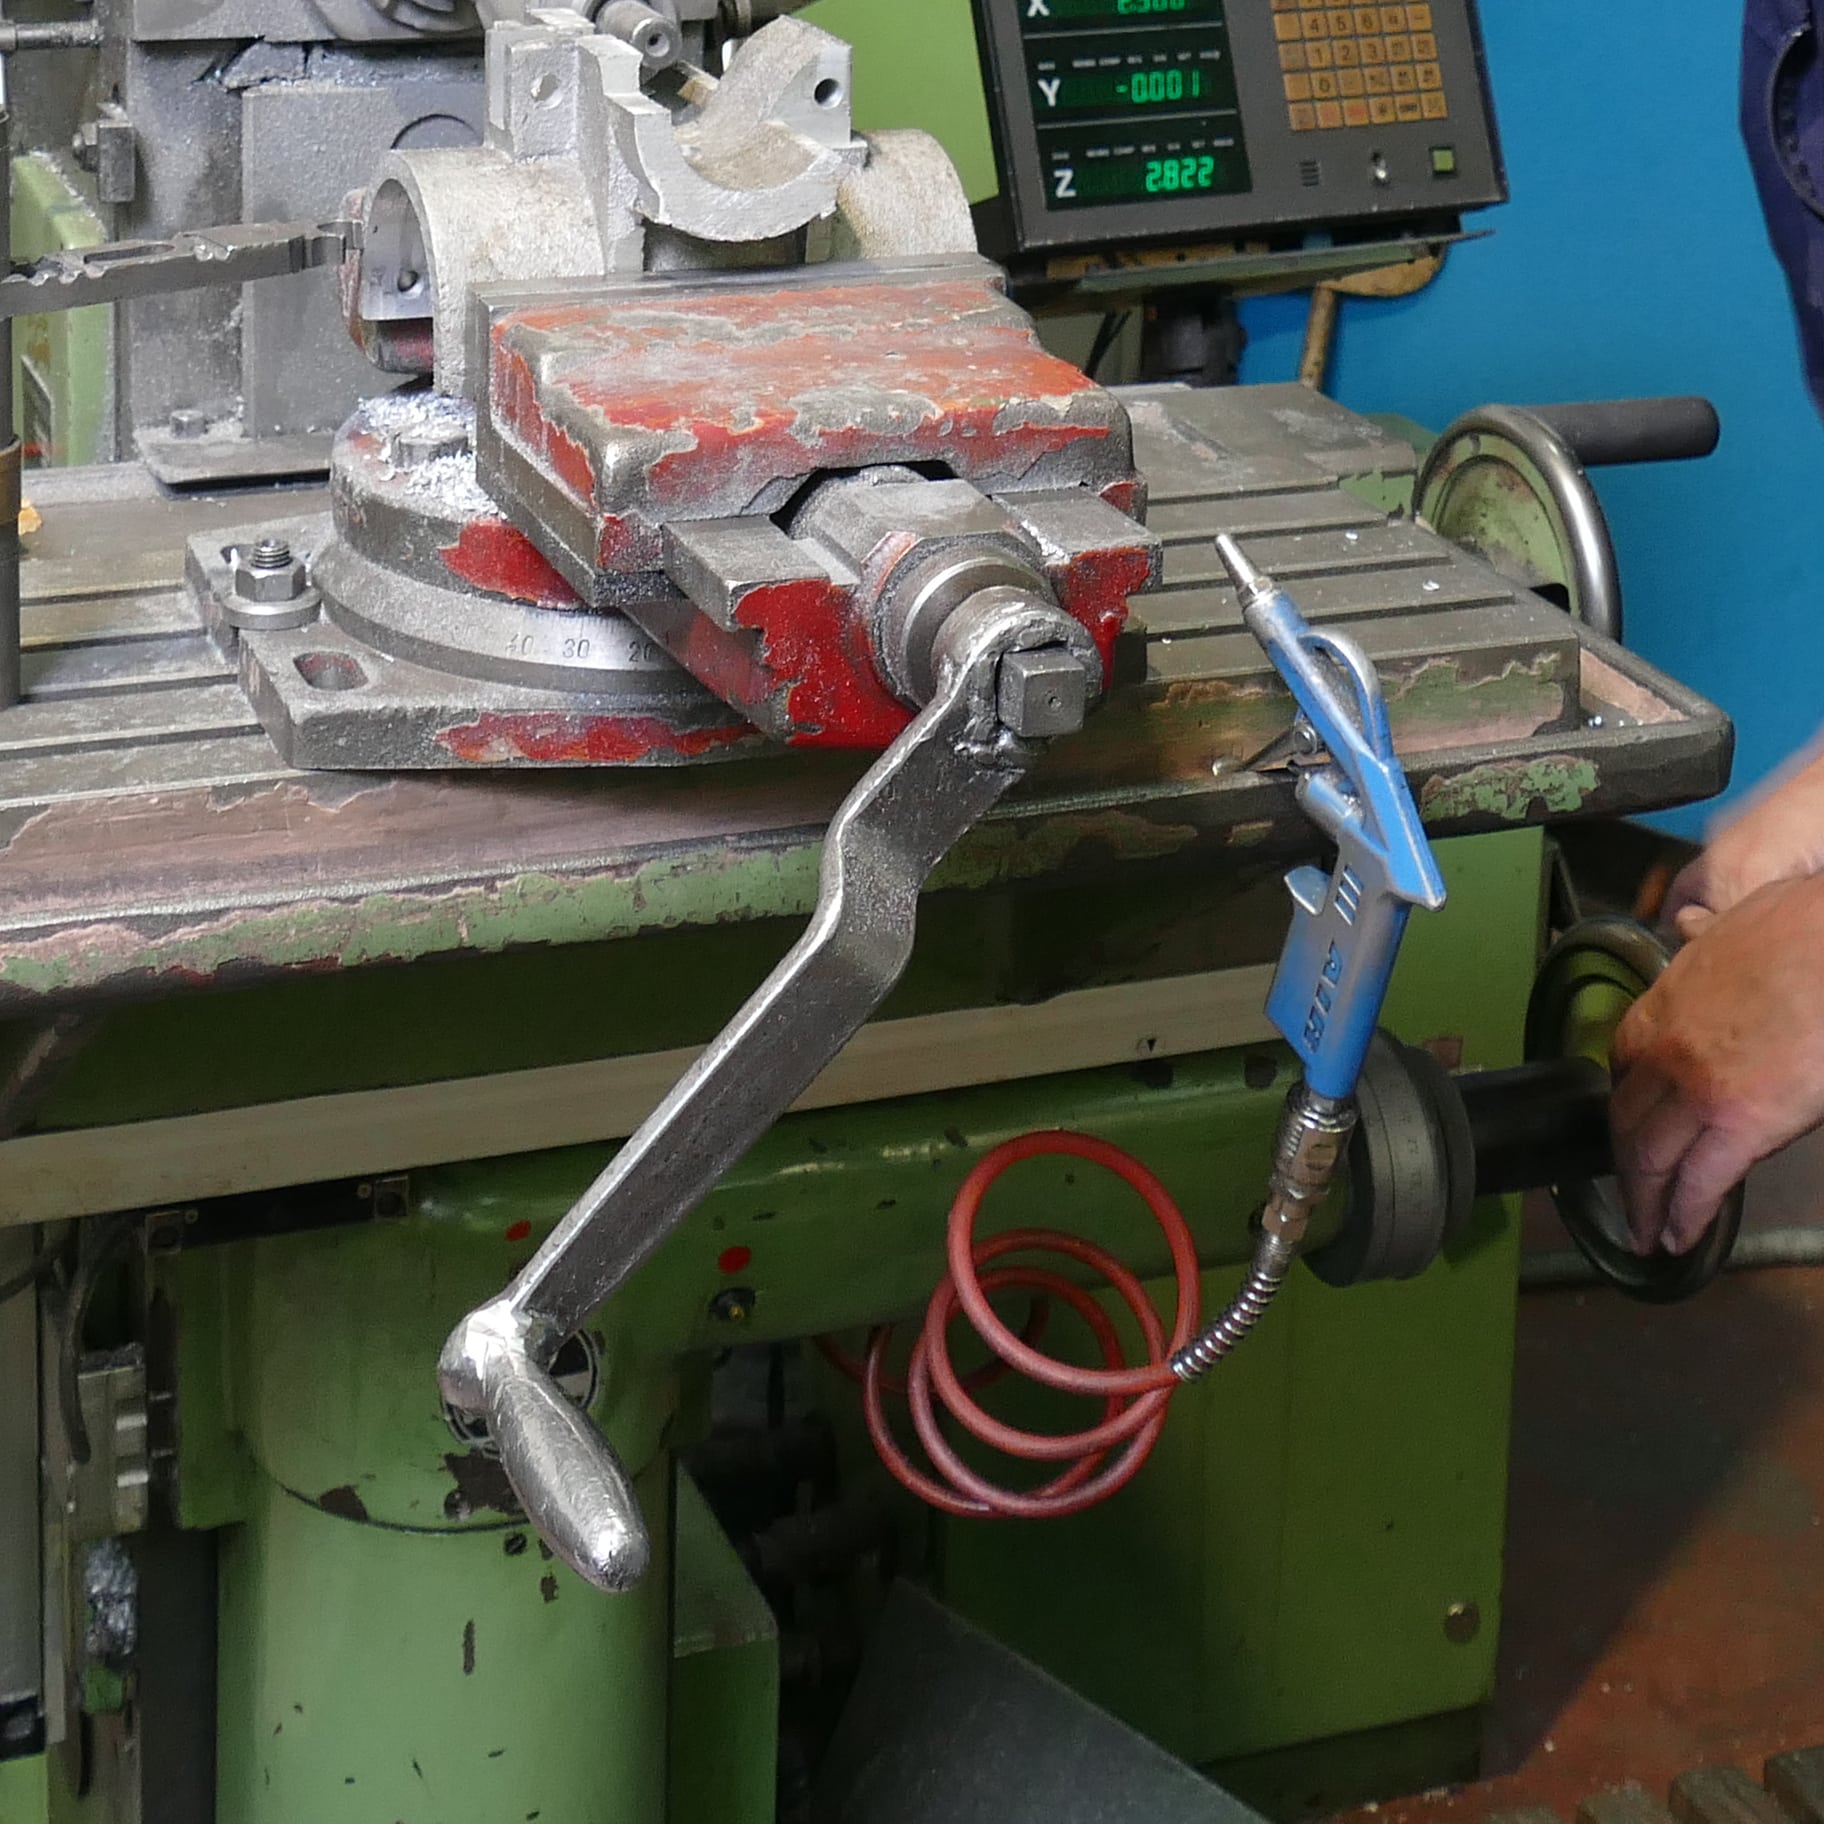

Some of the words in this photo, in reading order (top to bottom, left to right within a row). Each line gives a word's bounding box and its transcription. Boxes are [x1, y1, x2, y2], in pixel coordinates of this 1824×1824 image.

[1037, 78, 1061, 107] Y
[1053, 168, 1076, 198] Z
[562, 638, 591, 659] 30
[628, 641, 654, 663] 20
